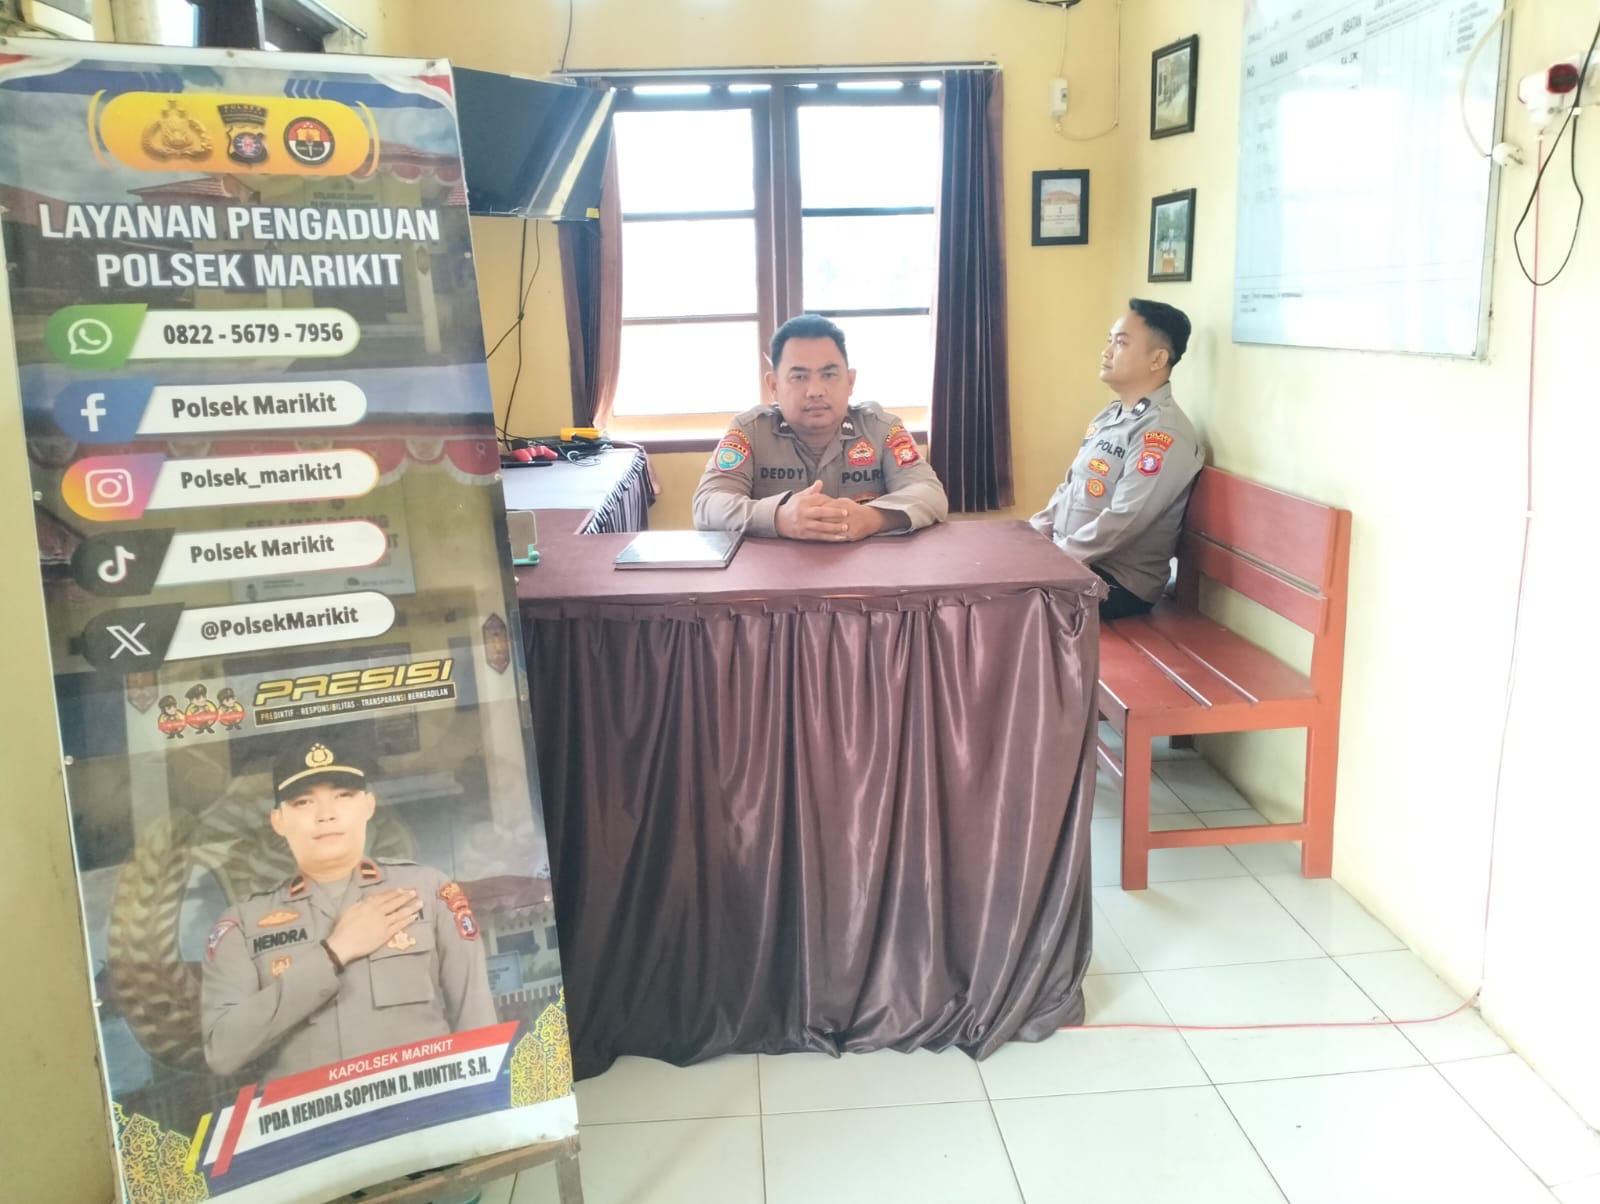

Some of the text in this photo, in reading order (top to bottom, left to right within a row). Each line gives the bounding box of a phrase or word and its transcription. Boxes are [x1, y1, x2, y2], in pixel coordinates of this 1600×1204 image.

[38, 202, 441, 242] LAYANAN PENGADUAN
[96, 252, 402, 288] POLSEK MARIKIT
[163, 324, 214, 345] 0822
[231, 323, 279, 344] 5679
[295, 322, 344, 343] 7956
[171, 392, 337, 418] Polsek Marikit
[1096, 439, 1126, 459] POLRI
[181, 463, 343, 490] Polsek_marikit1
[760, 466, 804, 481] DEDDY
[842, 468, 885, 485] POLR
[190, 534, 335, 564] Polsek Marikit
[200, 606, 359, 641] @PolsekMarikit
[254, 659, 453, 705] PRESISI
[260, 708, 294, 721] PREDIKTIF
[300, 701, 356, 715] RESPONSIBILITAS
[361, 695, 406, 707] TRANSPARANSI
[407, 688, 449, 701] BERKEADILAN
[253, 928, 308, 952] HENDRA
[328, 1039, 453, 1081] KAPOLSEK MARIKIT
[258, 1055, 491, 1136] IPDA HENDRA SOPIYAN D. MUNTHE, S.H.
